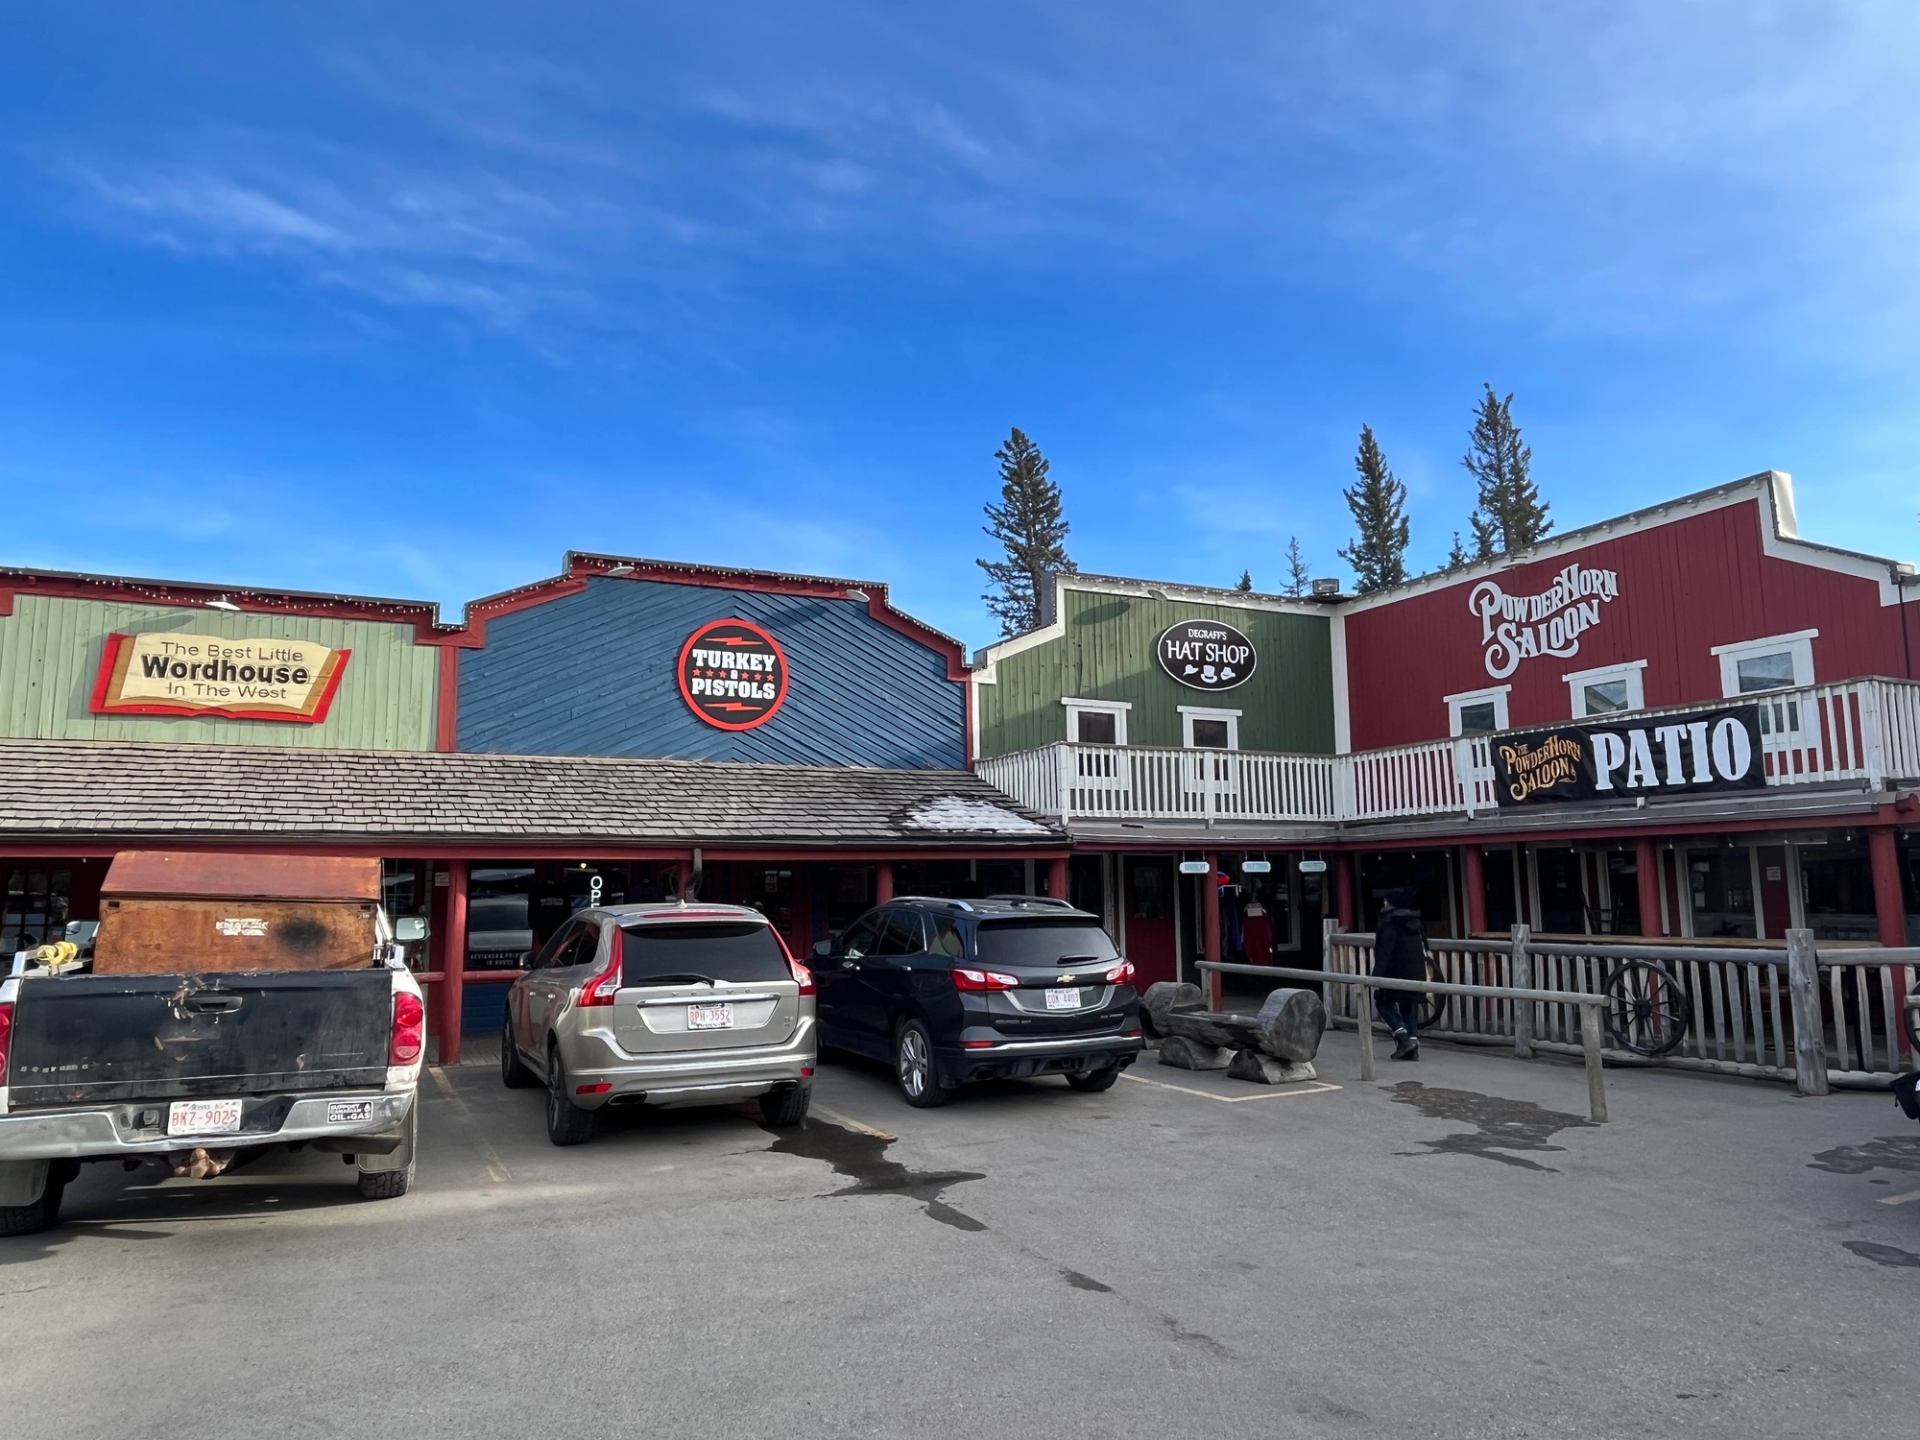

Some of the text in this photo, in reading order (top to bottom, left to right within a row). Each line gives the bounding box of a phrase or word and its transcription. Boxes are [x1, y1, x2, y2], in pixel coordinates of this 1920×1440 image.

[161, 641, 303, 662] The Best Little
[692, 649, 776, 672] TURKEY
[1166, 640, 1249, 665] HAT SHOP
[141, 654, 309, 684] Wordhouse
[168, 682, 287, 699] In The West
[691, 678, 776, 700] PISTOLS
[1590, 717, 1751, 790] PATIO
